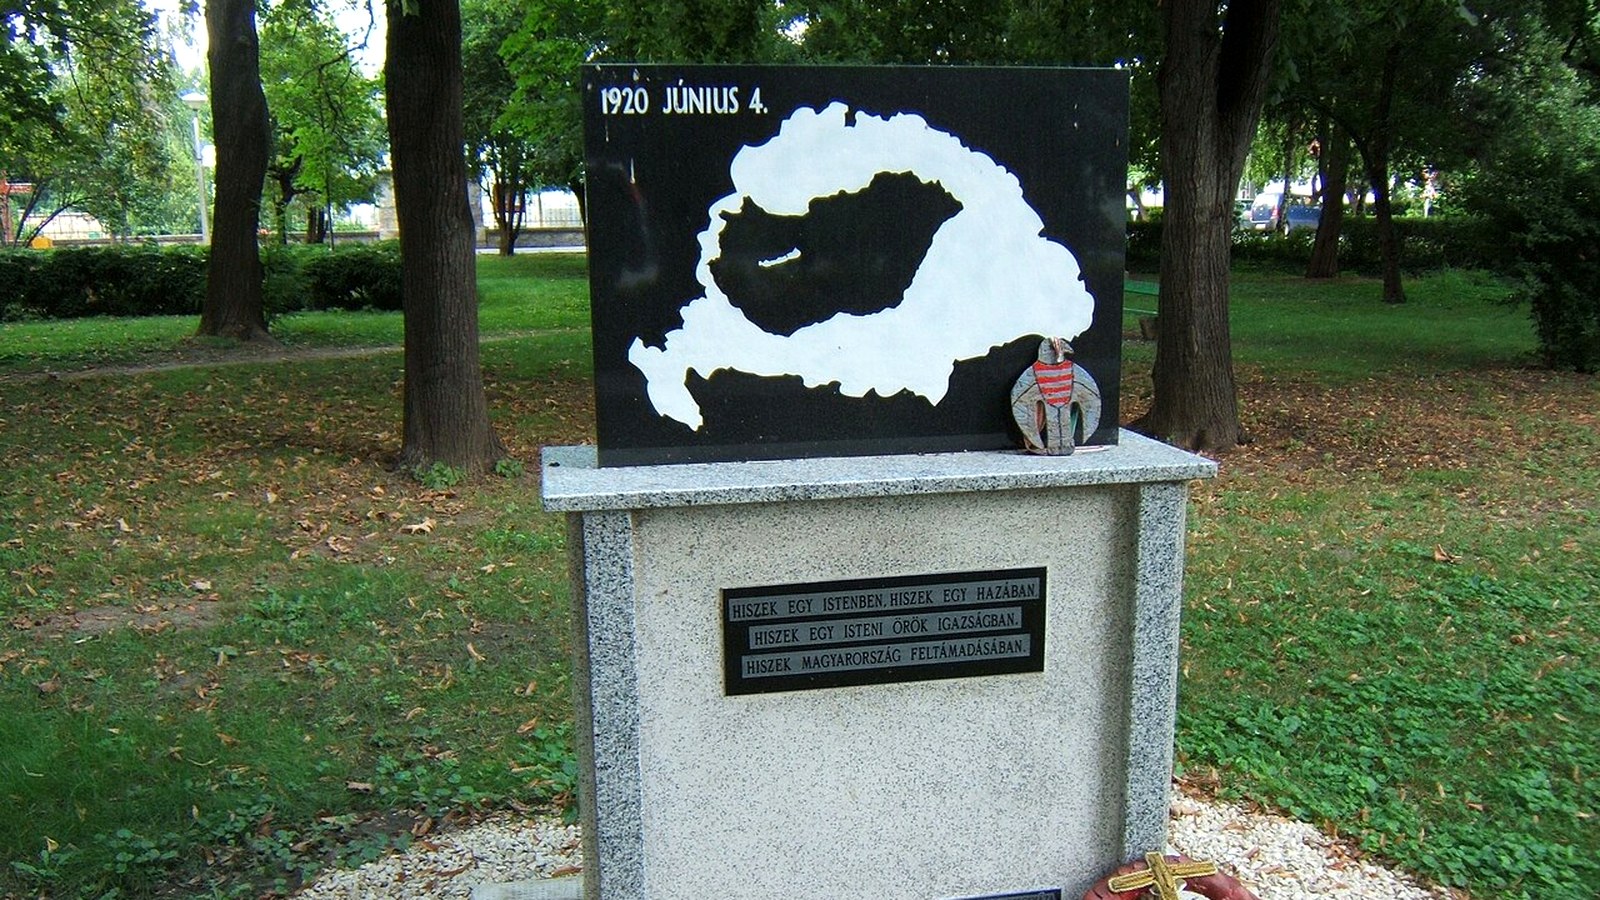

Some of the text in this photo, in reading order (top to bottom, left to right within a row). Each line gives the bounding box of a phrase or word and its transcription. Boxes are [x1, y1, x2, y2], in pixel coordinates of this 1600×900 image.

[601, 79, 768, 114] 1920 JÚNIUS 4.
[732, 600, 778, 617] HISZEK
[788, 599, 813, 614] EGY
[890, 589, 933, 606] HISZEK
[943, 588, 967, 603] EGY
[754, 611, 1018, 645] HISZEK EGY ISTENI ÖRÖK IGAZSÁGBAN.
[746, 638, 1027, 675] HISZEK MAGYARORSZÁG FELTÁMADÁSÁBAN.
